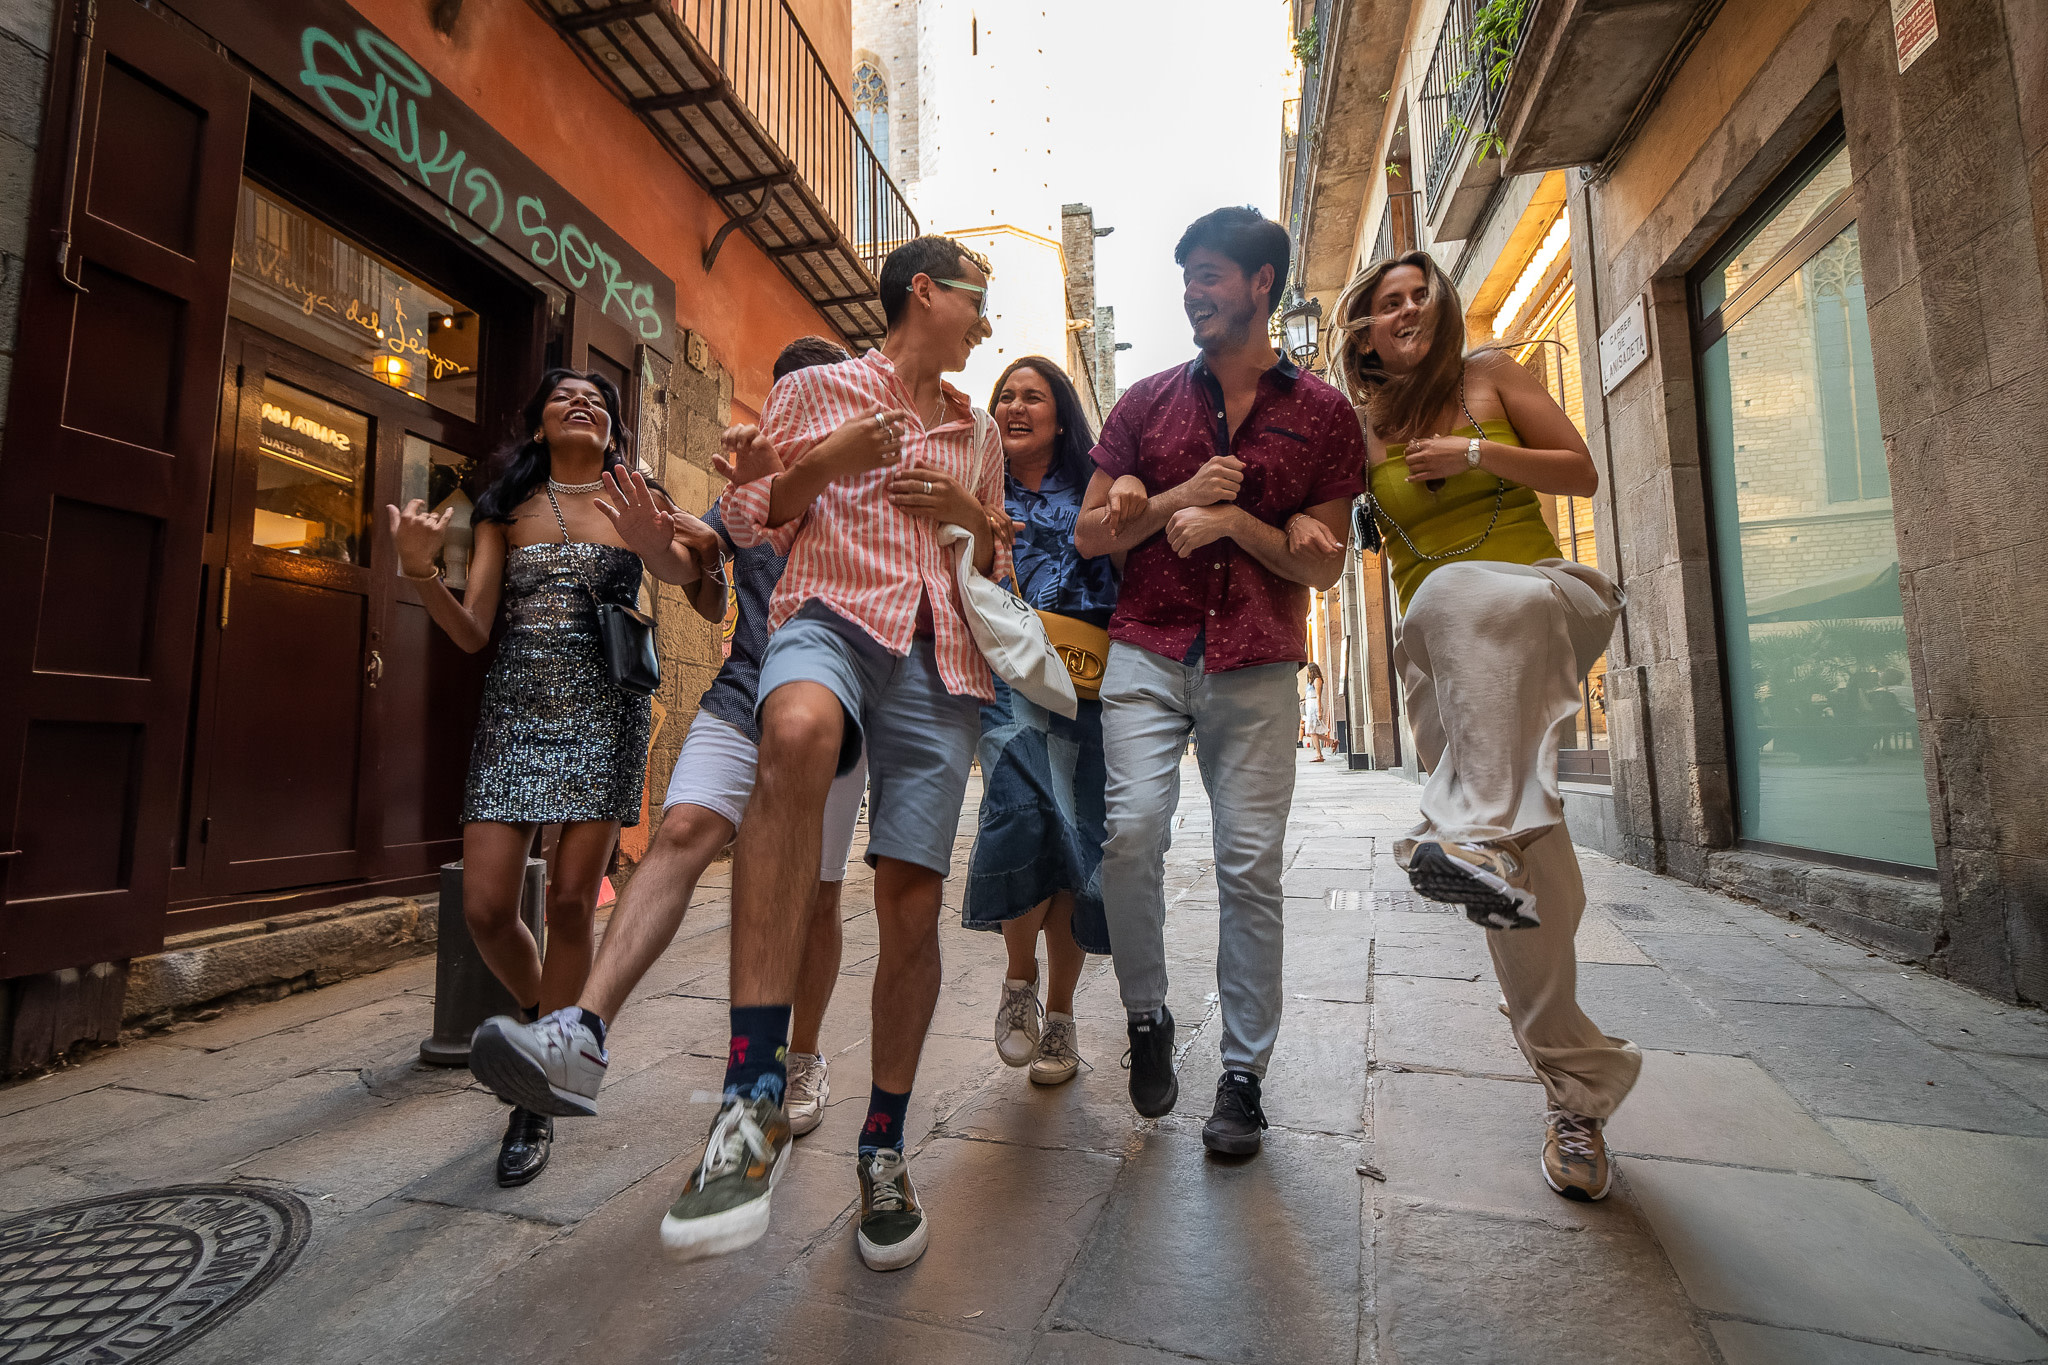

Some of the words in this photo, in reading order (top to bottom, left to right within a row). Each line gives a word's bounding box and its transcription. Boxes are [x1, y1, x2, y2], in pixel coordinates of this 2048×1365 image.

[257, 248, 338, 315] Vinya
[346, 299, 379, 332] del
[1609, 316, 1632, 345] CARRER
[694, 340, 702, 362] 5
[1617, 336, 1625, 351] DE
